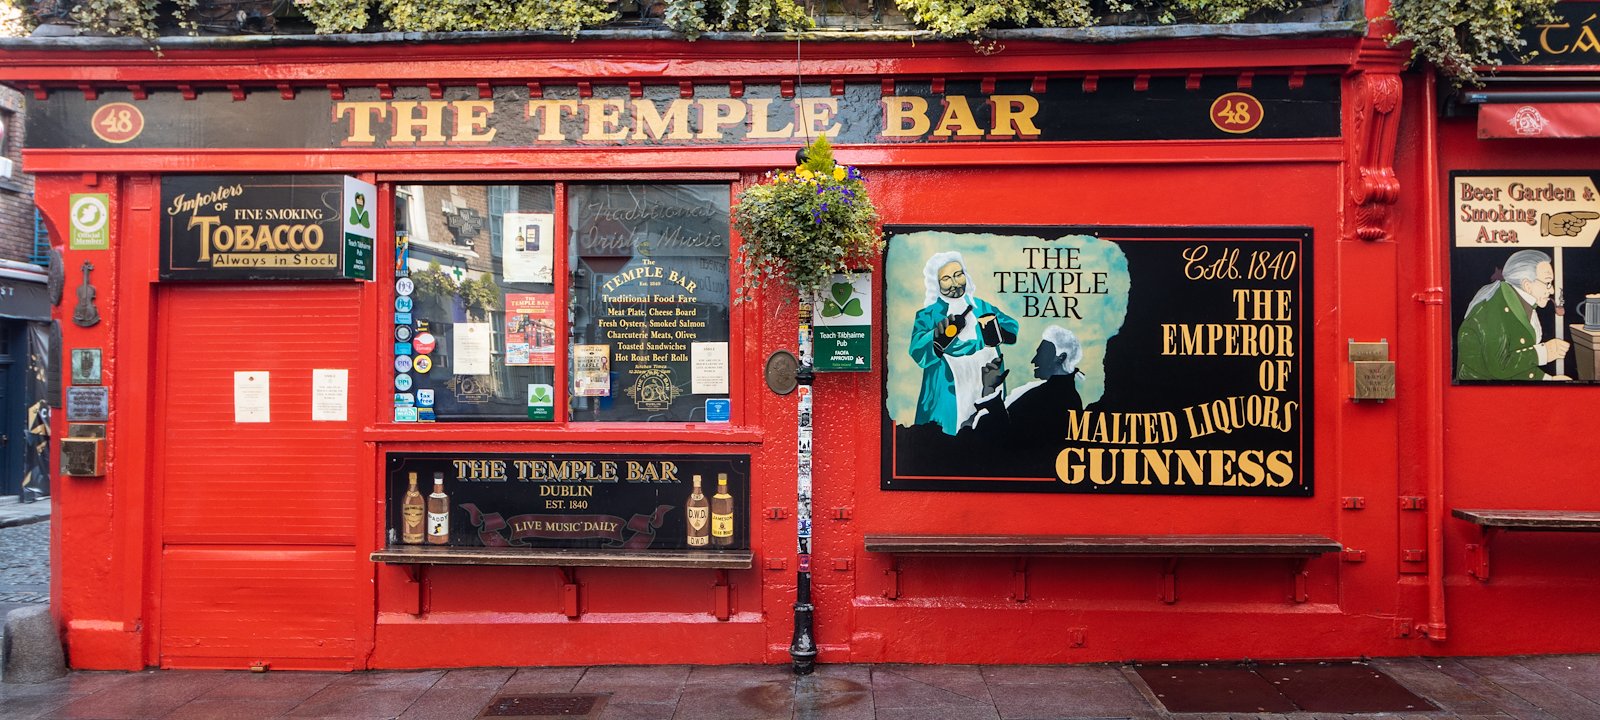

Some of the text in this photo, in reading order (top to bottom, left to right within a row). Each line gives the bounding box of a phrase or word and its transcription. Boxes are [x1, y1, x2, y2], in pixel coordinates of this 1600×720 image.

[99, 111, 132, 133] 48
[332, 95, 1041, 146] THE TEMPLE BAR
[1217, 100, 1251, 125] 48
[167, 184, 243, 216] Importers
[1460, 182, 1595, 201] Beer Garden &
[214, 203, 228, 212] OF
[234, 208, 323, 220] FINE SMOKING
[588, 199, 717, 222] Traditional
[1460, 203, 1537, 226] Smoking
[187, 216, 325, 263] TOBACCO
[583, 225, 722, 249] Irish Music
[1476, 225, 1519, 243] Area
[215, 254, 335, 266] Always in Stock
[1022, 247, 1082, 270] THE
[1182, 245, 1297, 280] Estb. 1840
[603, 266, 664, 293] TEMPLE
[668, 270, 697, 294] BAR
[993, 271, 1109, 294] TEMPLE
[602, 294, 697, 303] Traditional Food Fare
[1022, 295, 1083, 320] BAR
[1232, 289, 1292, 321] THE
[607, 308, 697, 317] Meat Plate, Cheese Board
[598, 319, 705, 330] Fresh Oysters, Smoked Salmon
[607, 331, 697, 340] Charcuterie Meats, Olives
[820, 331, 836, 339] Teach
[617, 341, 686, 350] Toasted Sandwiches
[1161, 323, 1295, 357] EMPEROR
[615, 353, 689, 362] Hot Roast Beef Rolls
[1259, 359, 1292, 391] OF
[1065, 394, 1299, 445] MALTED LIQUORS
[452, 459, 681, 483] THE TEMPLE BAR
[1055, 447, 1294, 487] GUINNESS
[539, 485, 593, 496] DUBLIN
[545, 500, 588, 509] EST. 1840
[688, 509, 707, 519] D.W.D.
[515, 521, 618, 532] LIVE MUSIC DAILY
